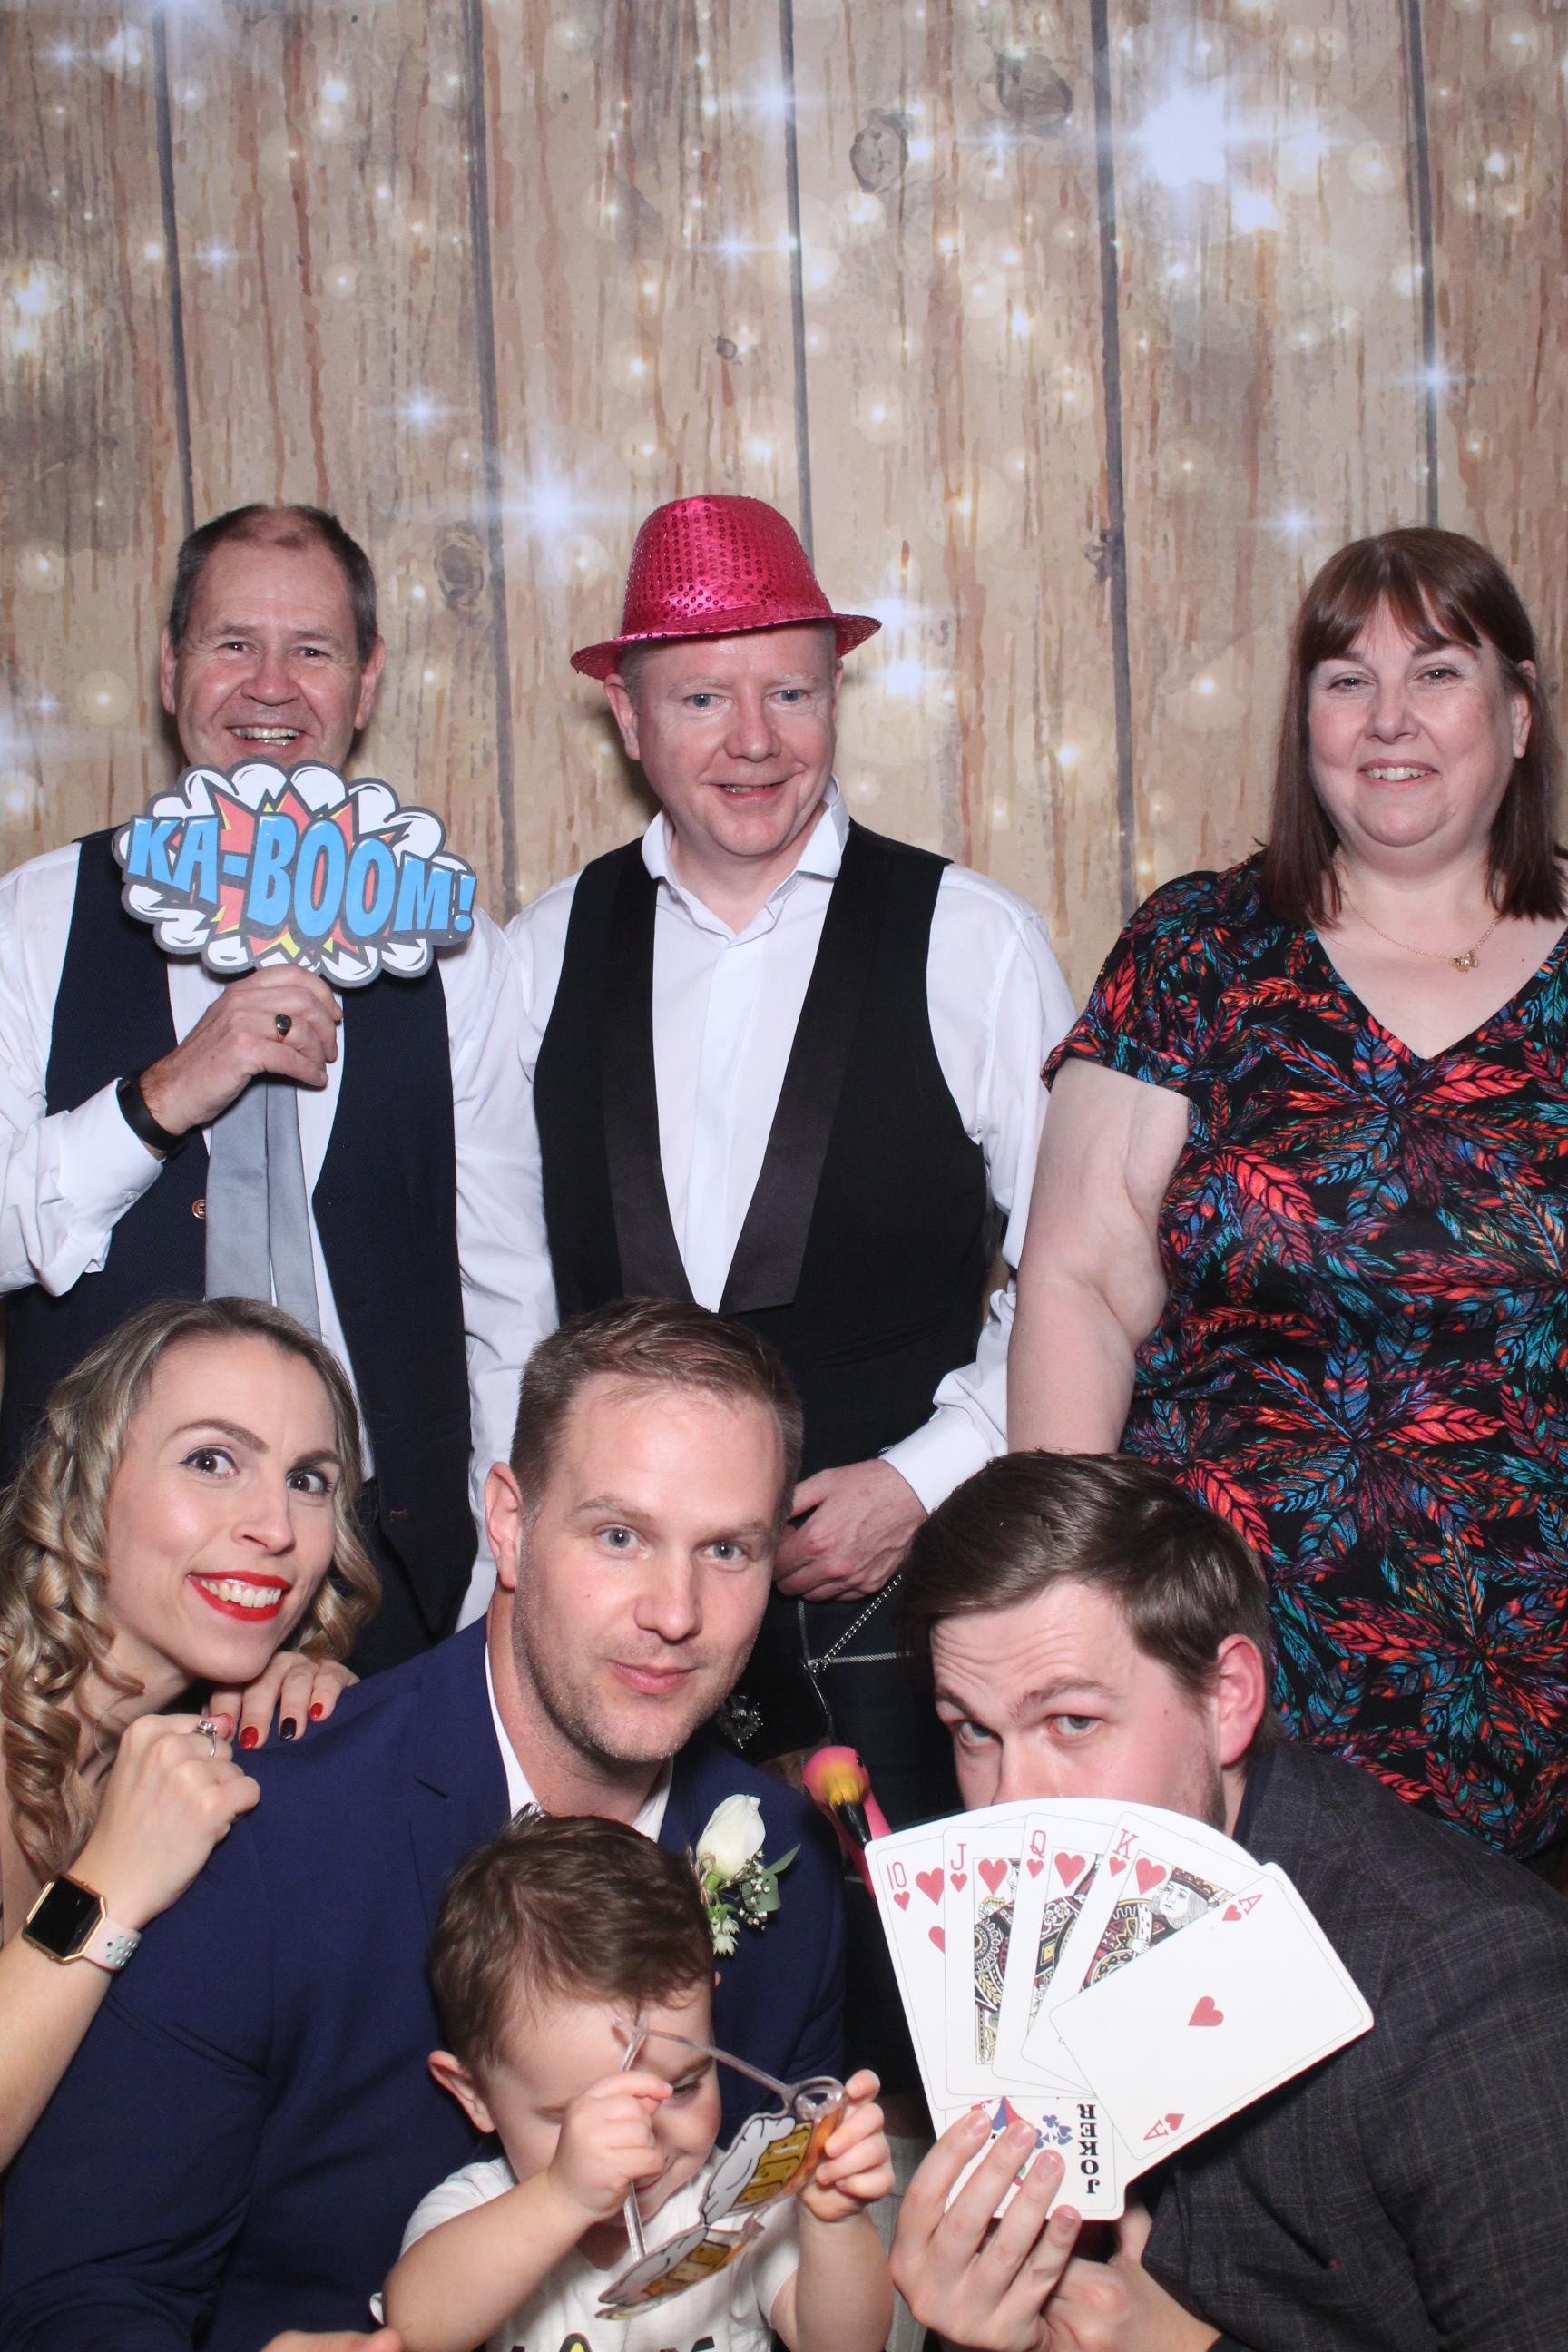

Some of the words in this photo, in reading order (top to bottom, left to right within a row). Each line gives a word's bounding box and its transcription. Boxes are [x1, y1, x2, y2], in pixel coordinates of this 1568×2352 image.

[125, 816, 477, 938] KA-BOOM!
[950, 1843, 966, 1870] J
[1029, 1829, 1046, 1858] Q
[1112, 1828, 1139, 1860] K
[886, 1861, 907, 1889] 10
[1238, 1894, 1264, 1915] A
[1143, 2119, 1170, 2141] A
[1077, 2103, 1100, 2194] JOKER
